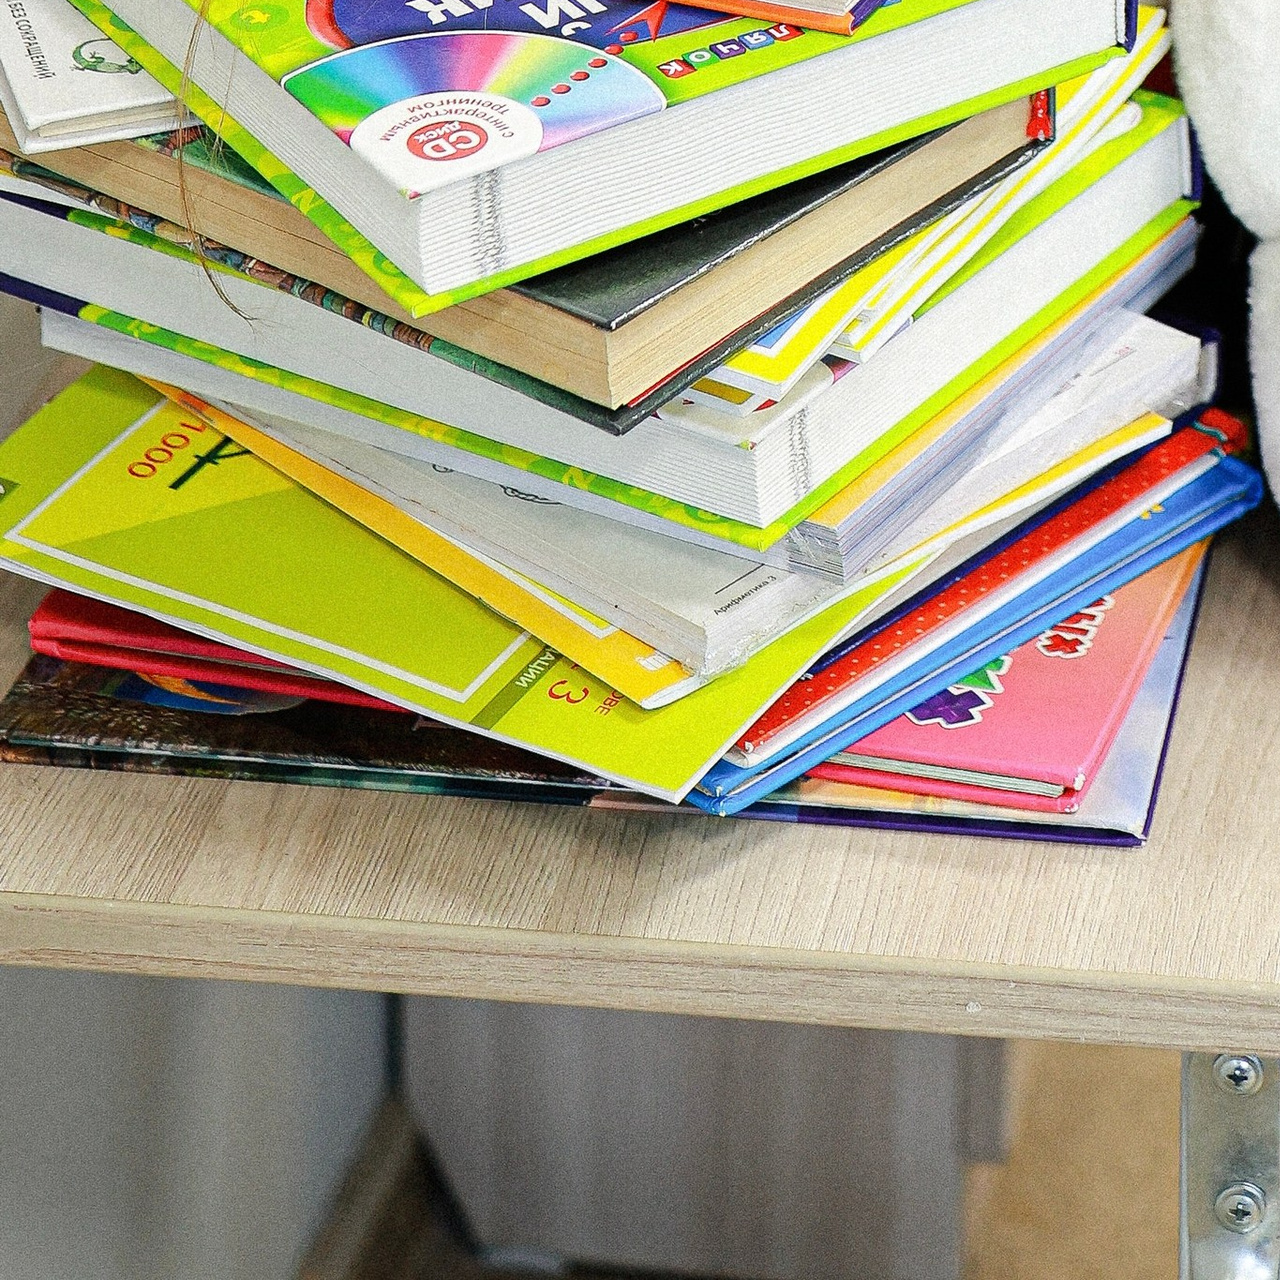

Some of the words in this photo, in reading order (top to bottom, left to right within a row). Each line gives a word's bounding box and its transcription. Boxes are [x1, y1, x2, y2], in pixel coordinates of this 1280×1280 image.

[16, 17, 57, 80] СОКРАЩЕНИЙ
[660, 25, 794, 77] ЛЯЧОК
[379, 106, 510, 142] интерактивным
[407, 97, 510, 116] тренингом
[422, 129, 481, 159] CD
[127, 420, 207, 480] 1000
[713, 579, 770, 616] Арифметика
